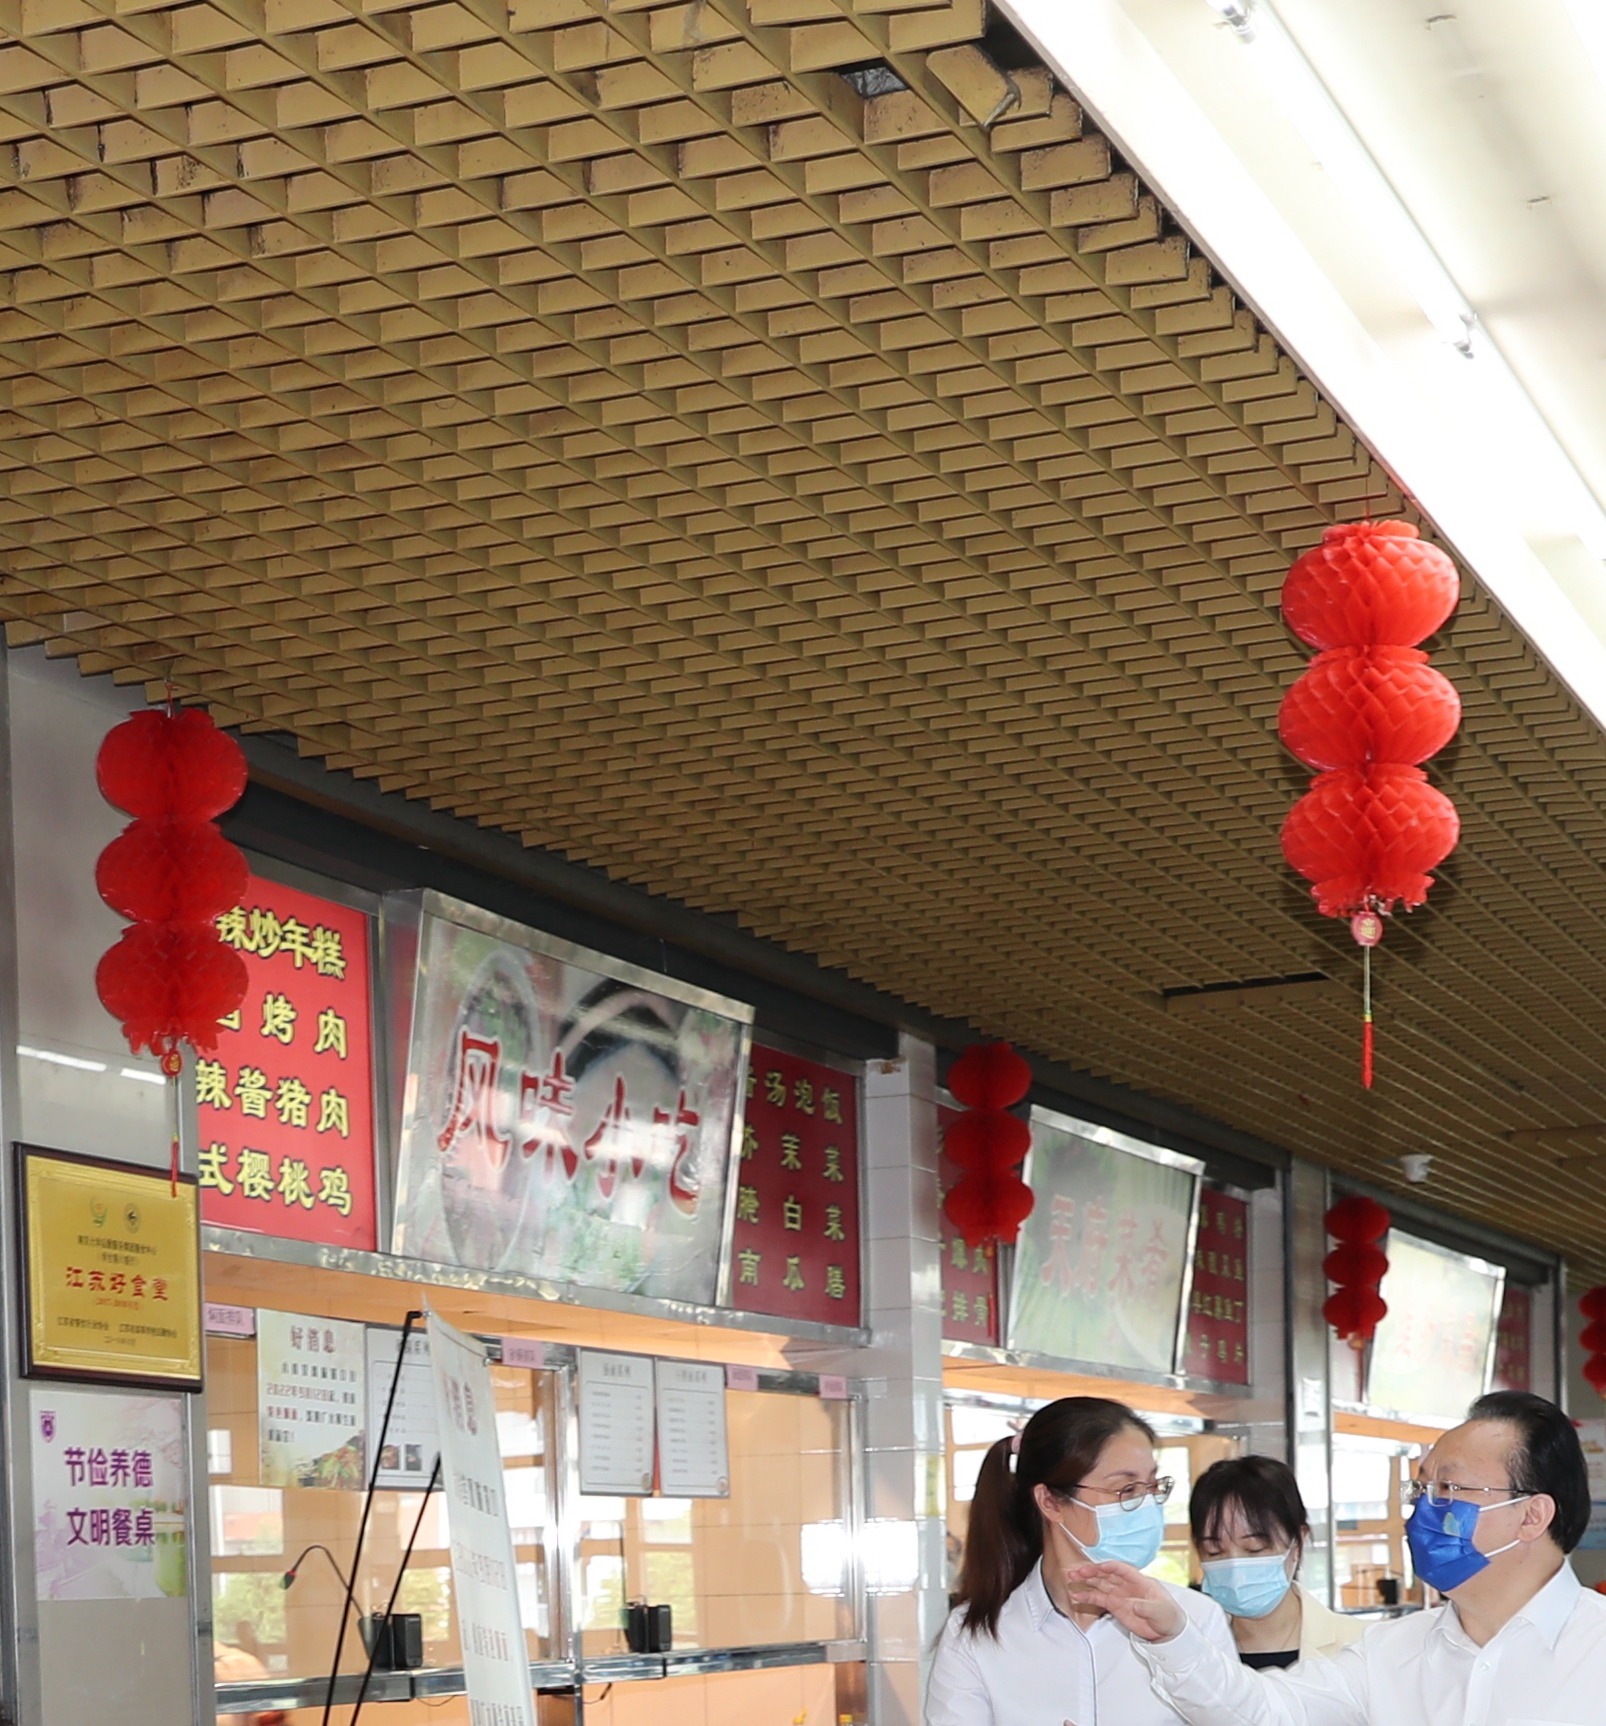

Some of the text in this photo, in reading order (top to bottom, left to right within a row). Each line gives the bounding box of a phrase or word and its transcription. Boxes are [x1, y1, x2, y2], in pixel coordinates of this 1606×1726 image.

[215, 992, 348, 1059] 烤肉
[65, 1265, 170, 1301] 江苏好食堂
[63, 1447, 154, 1488] 节俭养德
[65, 1507, 156, 1547] 文明餐桌
